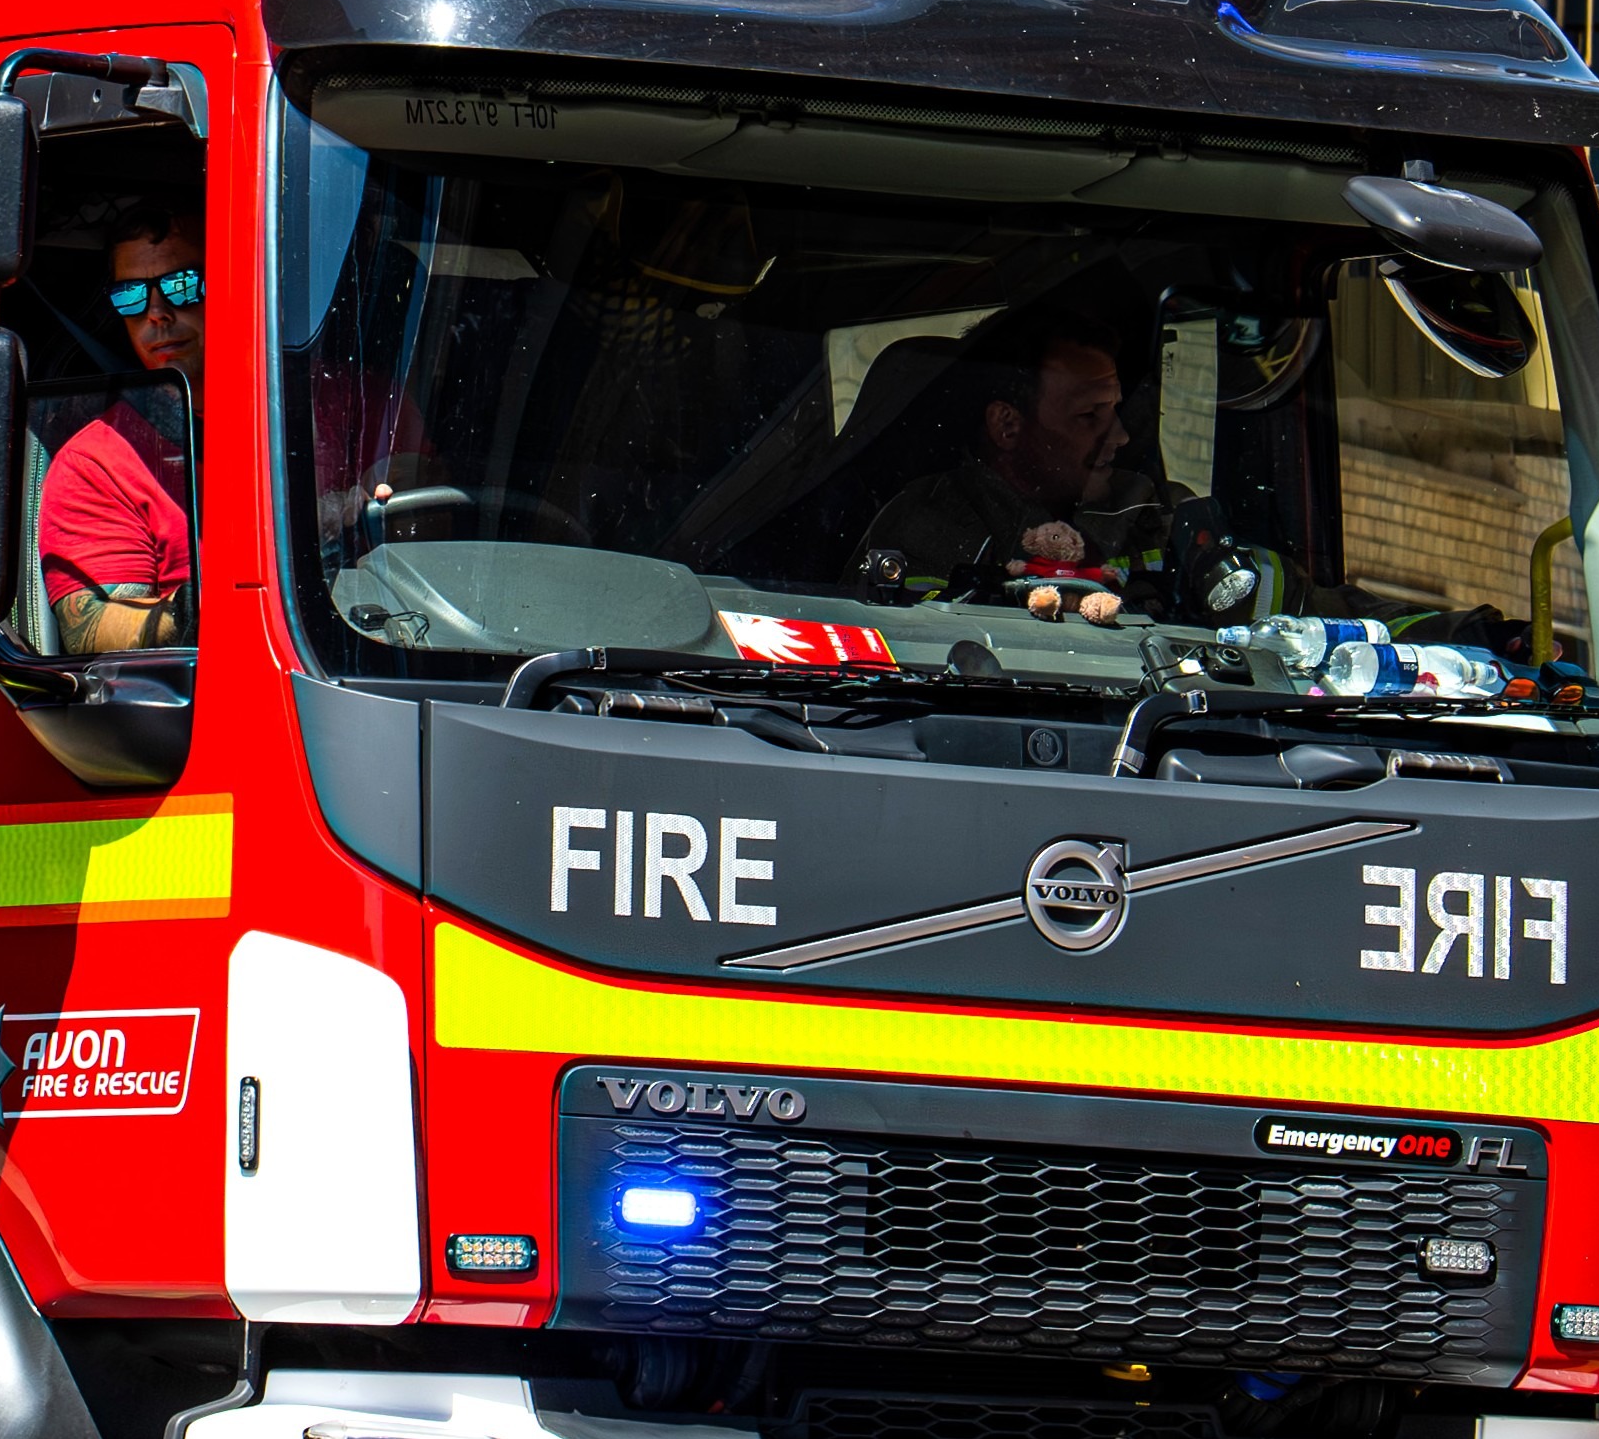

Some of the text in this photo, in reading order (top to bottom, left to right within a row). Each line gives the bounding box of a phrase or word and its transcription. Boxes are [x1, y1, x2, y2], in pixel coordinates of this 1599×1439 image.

[550, 806, 777, 926] FIRE
[1032, 884, 1119, 905] VOLVO
[22, 1029, 126, 1070] AVON
[22, 1071, 181, 1098] FIRE & RESCUE
[597, 1075, 806, 1121] VOLVO
[1466, 1136, 1528, 1172] FL
